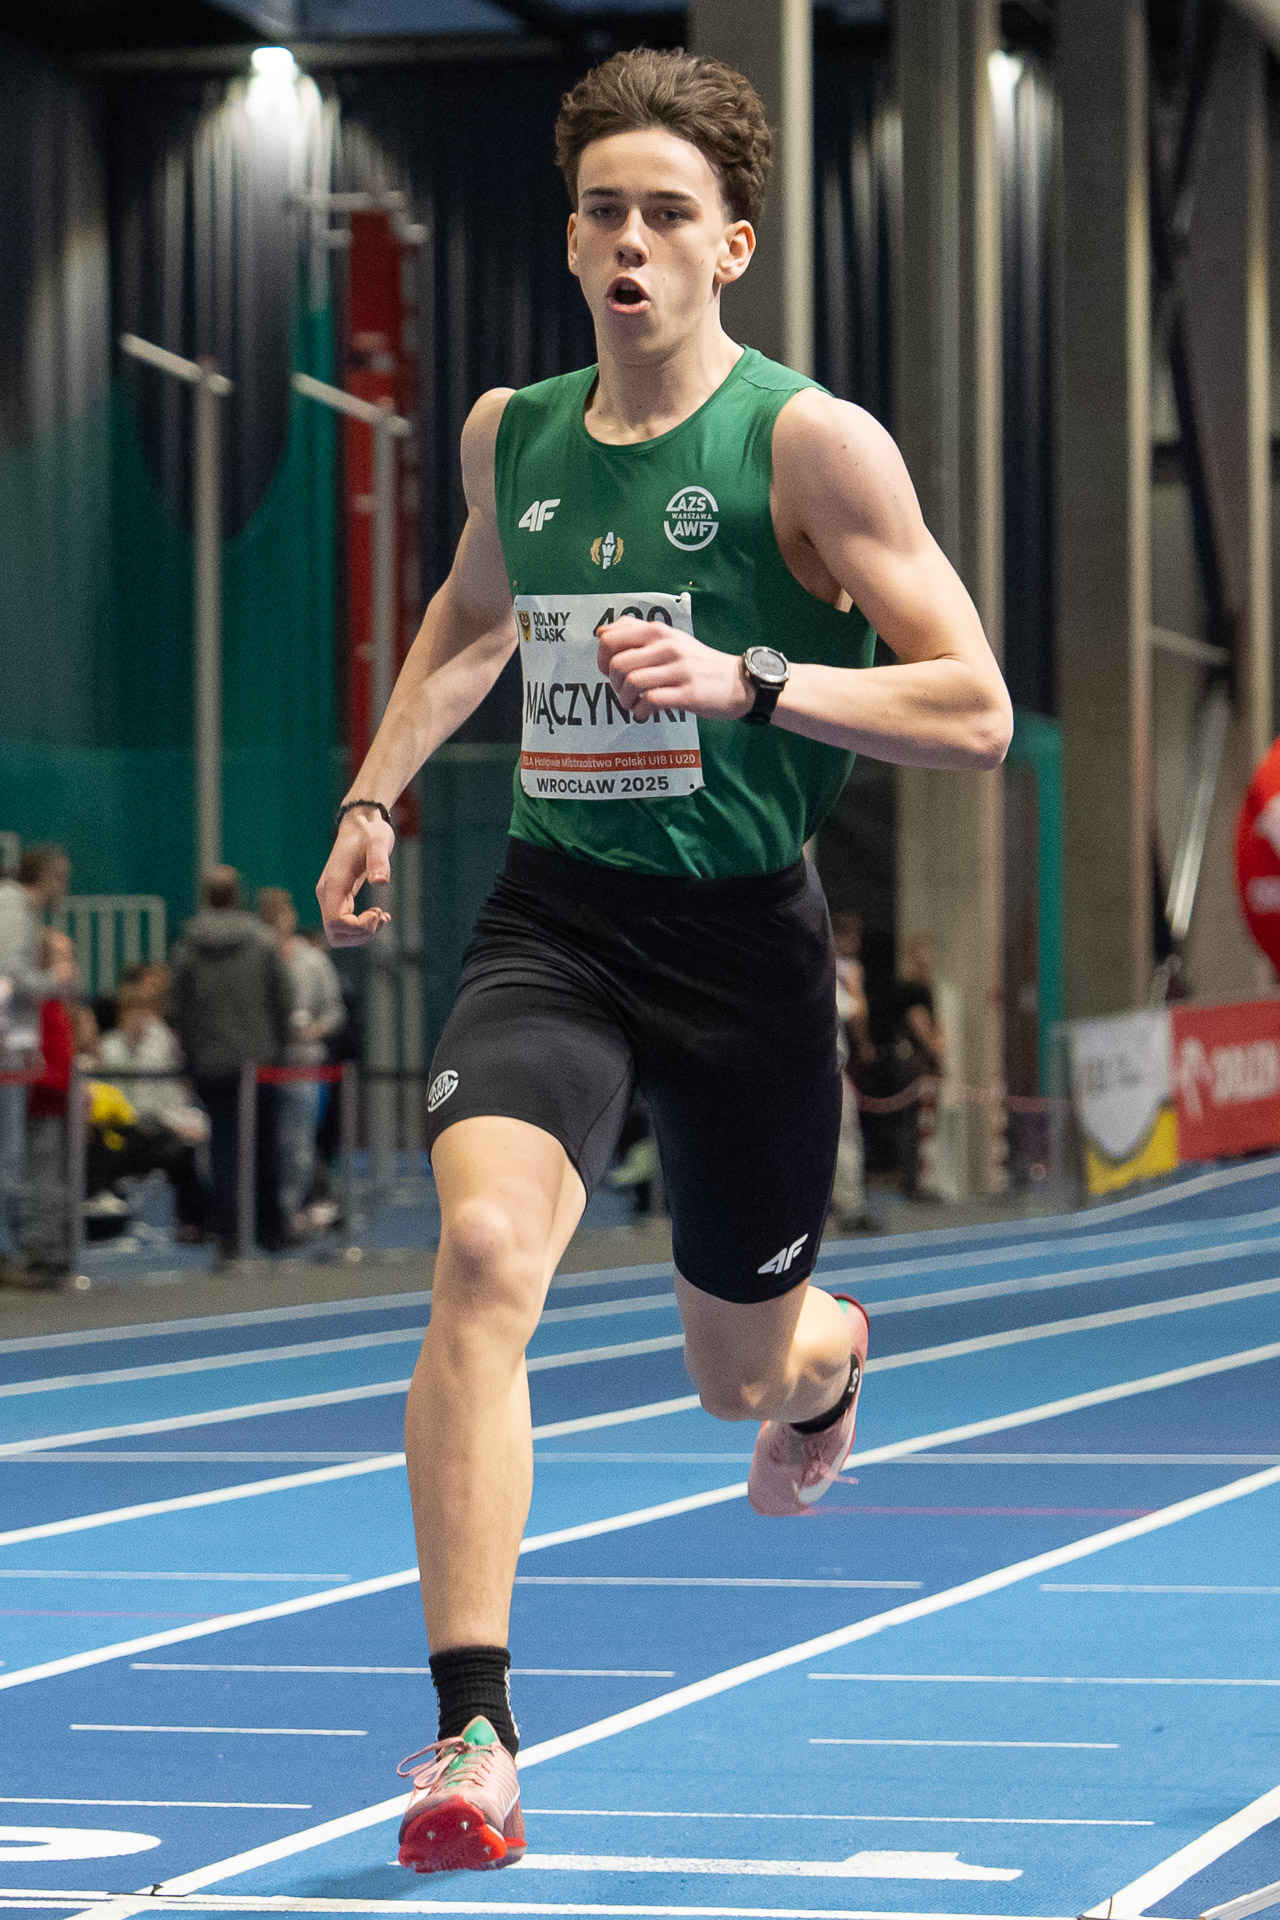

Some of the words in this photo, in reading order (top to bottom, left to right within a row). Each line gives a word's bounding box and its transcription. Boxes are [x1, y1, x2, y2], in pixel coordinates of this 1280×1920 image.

[677, 496, 707, 512] AZS
[518, 498, 561, 532] 4F
[671, 512, 712, 520] WARSZAWA
[673, 521, 709, 537] AWF
[532, 611, 571, 627] DOLNY
[534, 756, 560, 767] Halowe
[561, 757, 612, 768] Mistrzostwa
[614, 755, 646, 767] Polski
[648, 755, 667, 765] U18
[675, 754, 696, 764] U20
[536, 777, 616, 794] WROCŁAW
[620, 776, 669, 793] 2025
[757, 1233, 809, 1274] 4F
